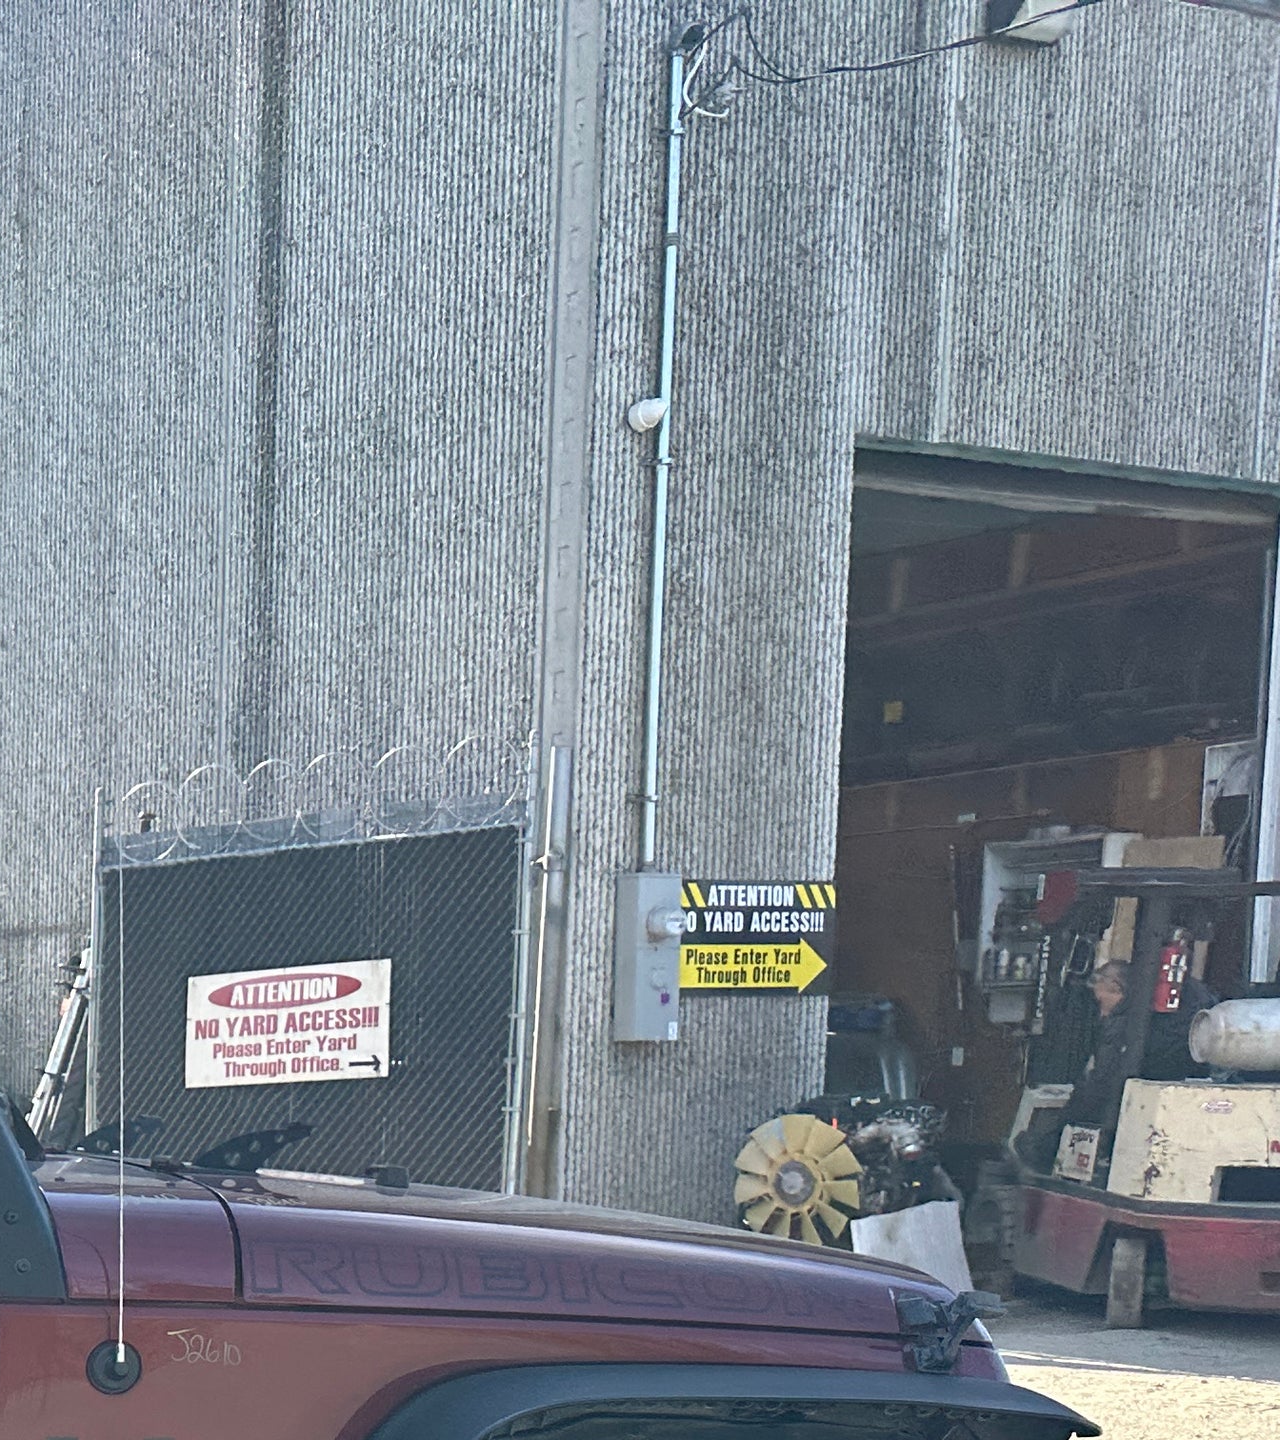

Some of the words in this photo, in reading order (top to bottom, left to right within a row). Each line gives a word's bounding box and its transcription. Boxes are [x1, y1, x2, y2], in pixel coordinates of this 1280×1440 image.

[707, 885, 794, 907] ATTENTION
[704, 912, 744, 933] YARD
[750, 911, 825, 933] ACCESS!!!
[685, 949, 728, 965] Please
[734, 949, 768, 965] Enter
[773, 948, 801, 965] Yard
[696, 967, 747, 985] Through
[752, 966, 791, 983] Office
[230, 976, 338, 1006] ATTENTION
[194, 1019, 220, 1040] NO
[226, 1014, 278, 1038] YARD
[284, 1006, 380, 1033] ACCESS!!!
[212, 1042, 262, 1059] Please
[266, 1038, 311, 1056] Enter
[316, 1034, 357, 1052] Yard
[224, 1059, 287, 1078] Through
[167, 1328, 242, 1366] J2610
